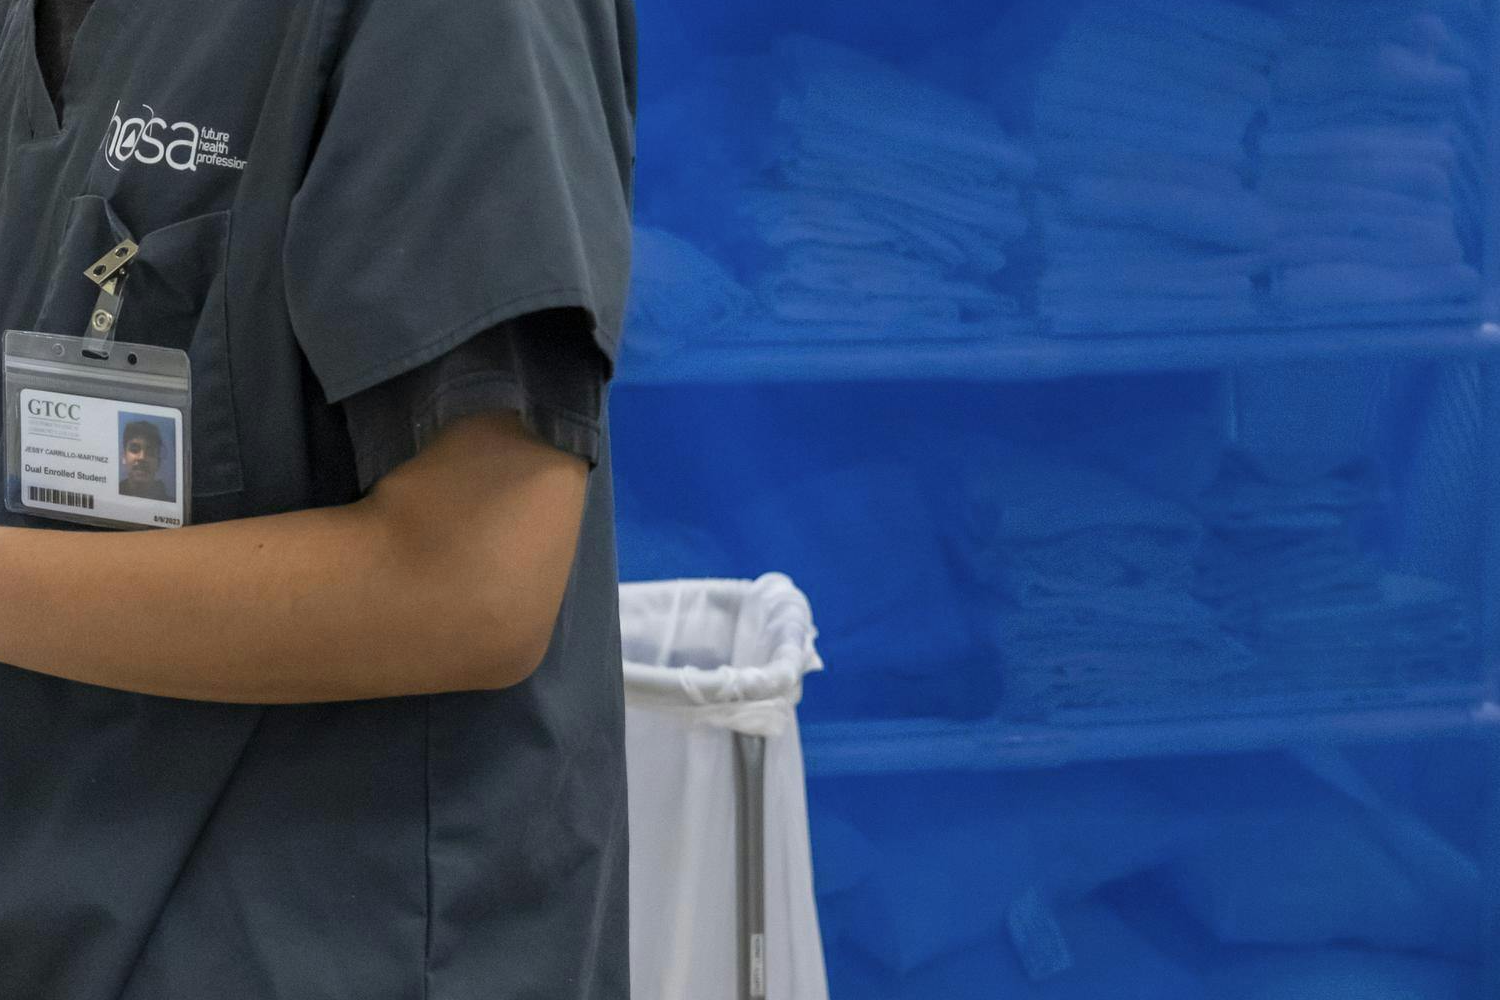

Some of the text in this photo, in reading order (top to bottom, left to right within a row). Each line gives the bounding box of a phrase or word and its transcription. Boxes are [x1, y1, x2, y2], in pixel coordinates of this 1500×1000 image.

[201, 126, 230, 142] future
[199, 139, 228, 155] health
[28, 399, 81, 421] GTCC
[25, 464, 107, 483] Dual Enrolled Student
